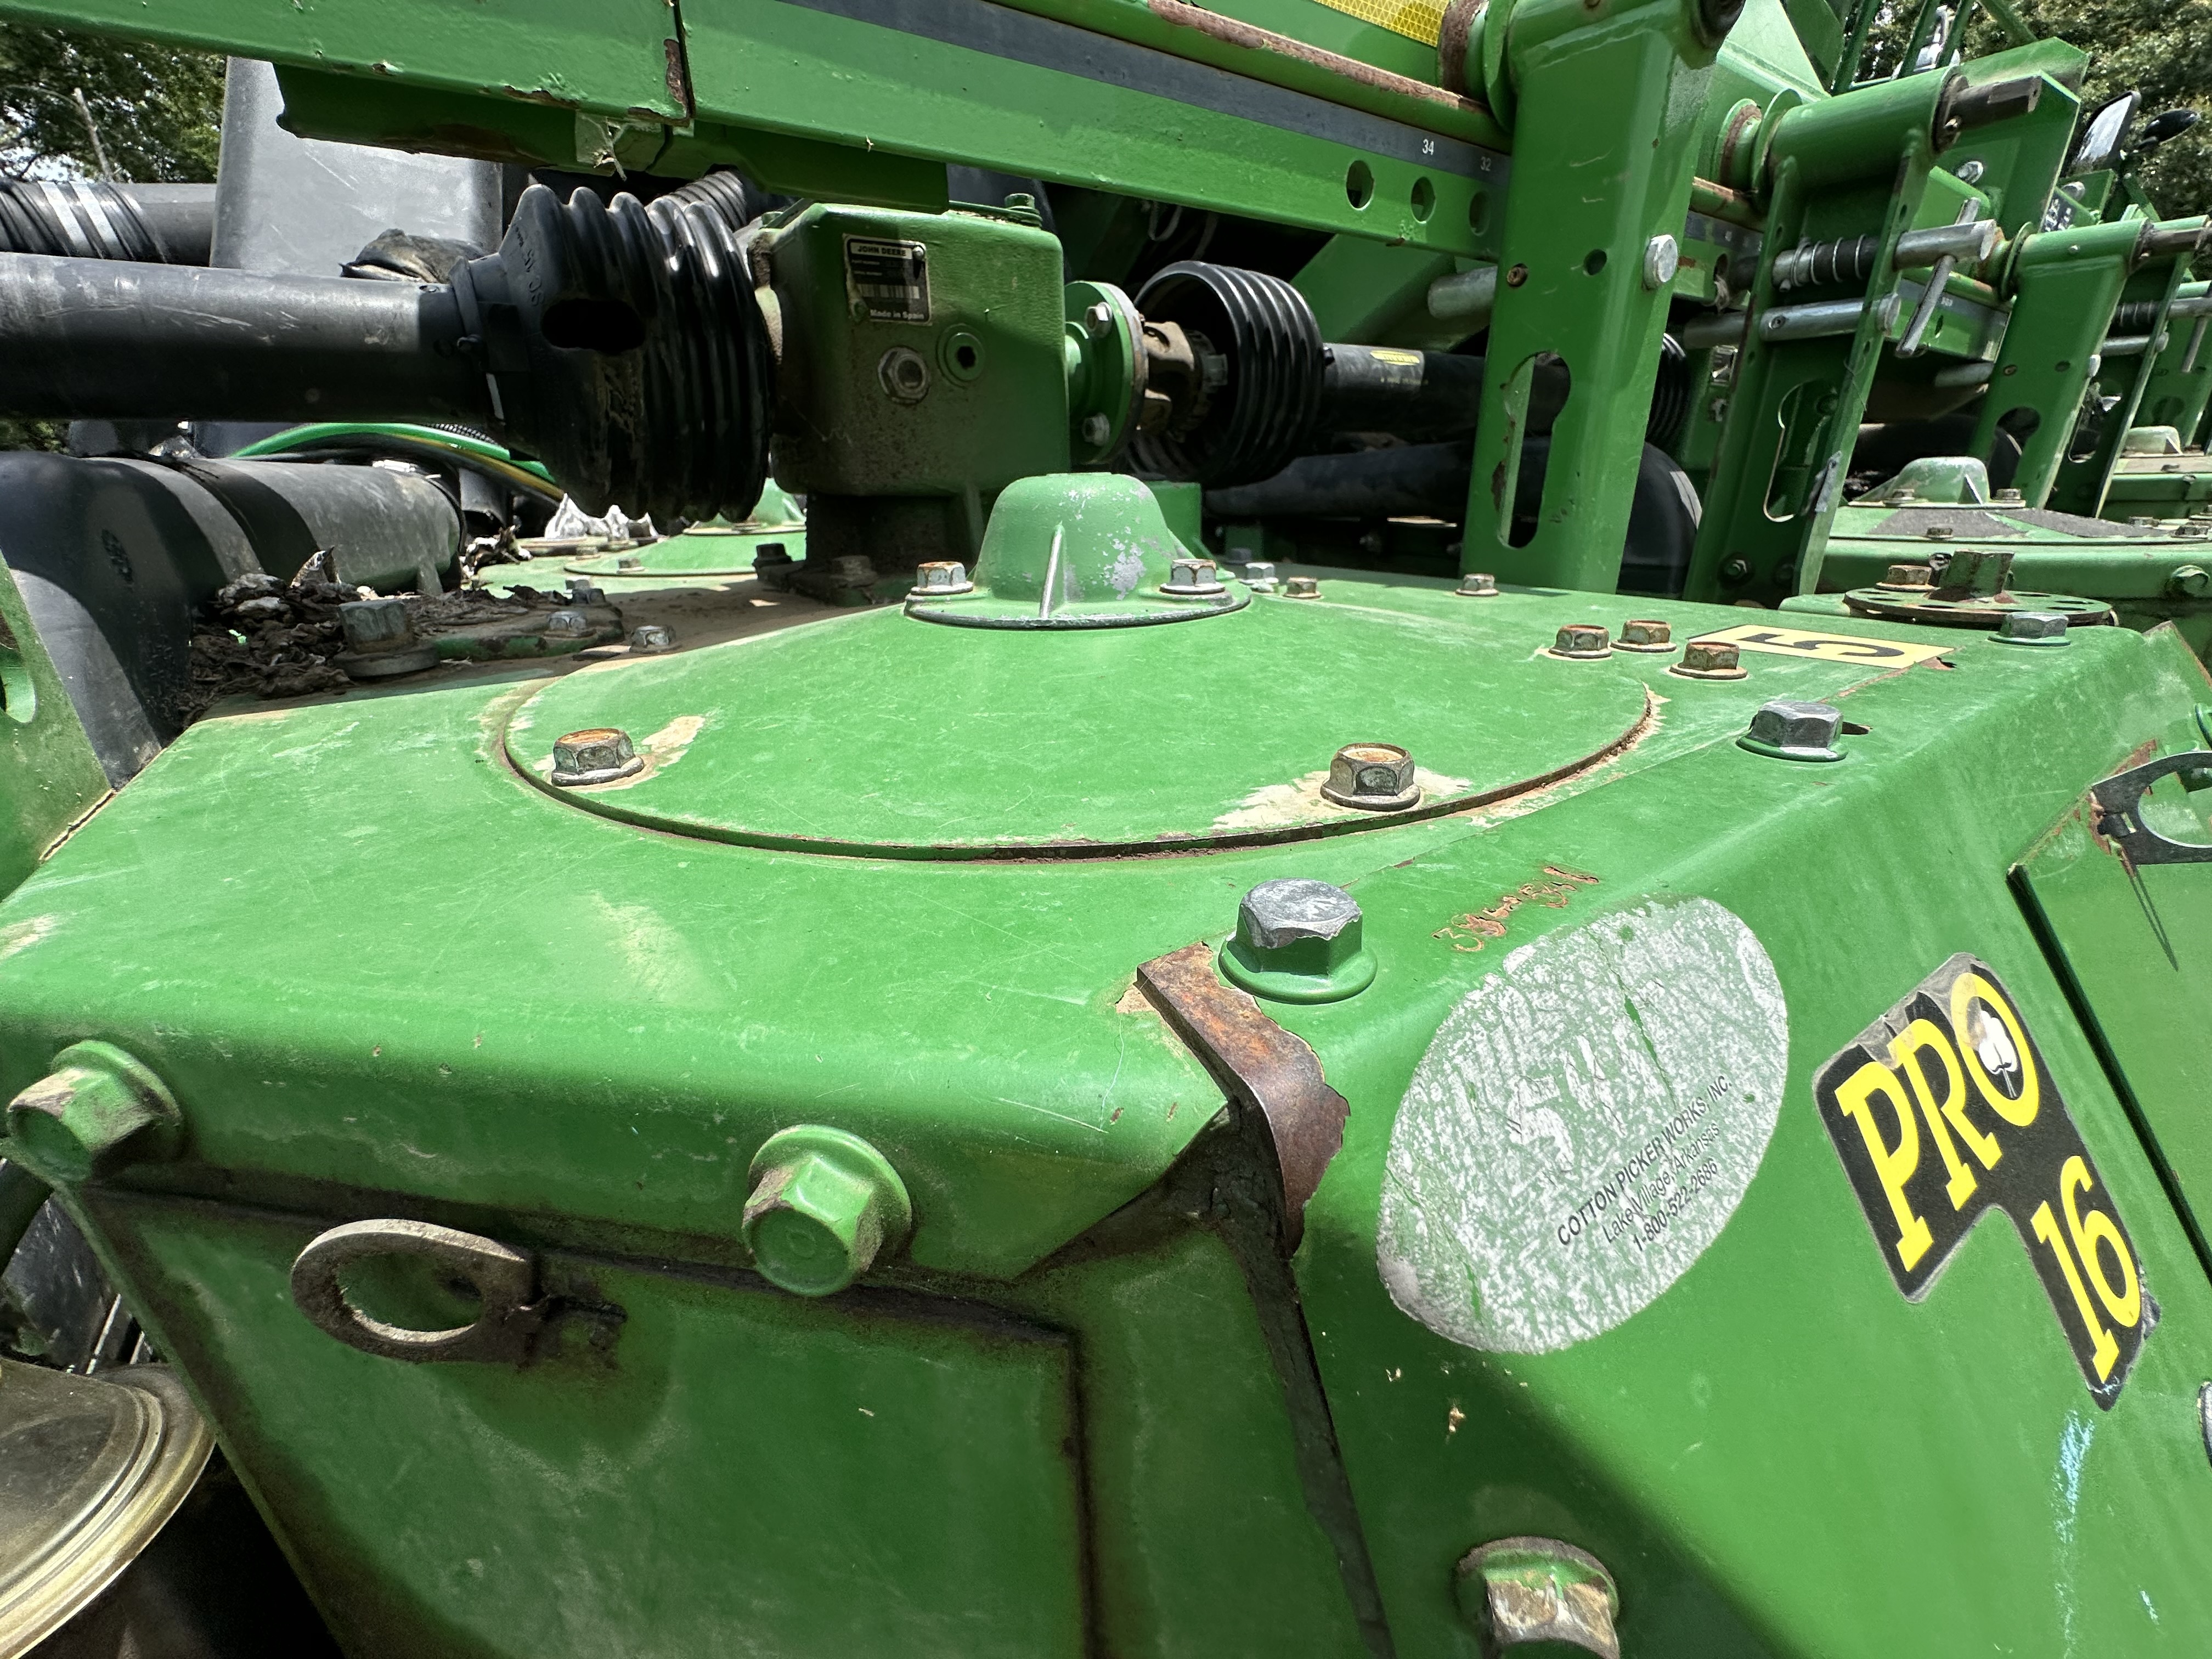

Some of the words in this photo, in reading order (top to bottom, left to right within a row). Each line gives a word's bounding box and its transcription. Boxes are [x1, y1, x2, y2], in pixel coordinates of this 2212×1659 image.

[1421, 139, 1434, 156] 34
[1480, 156, 1492, 171] 32
[857, 245, 879, 254] JOHN
[881, 247, 907, 257] DEERE
[1735, 632, 1905, 658] 5
[1558, 1181, 1618, 1245] COTTON
[1615, 1136, 1666, 1190] PICKER
[1661, 1096, 1712, 1145] WORKS,
[1707, 1075, 1733, 1103] INC.
[1834, 972, 2040, 1272] PRO
[1601, 1207, 1634, 1244] Lake
[1631, 1170, 1676, 1211] Village,
[1673, 1122, 1720, 1175] Arkansas
[1632, 1157, 1718, 1251] 1-800-522-2686
[2030, 1155, 2141, 1383] 16
